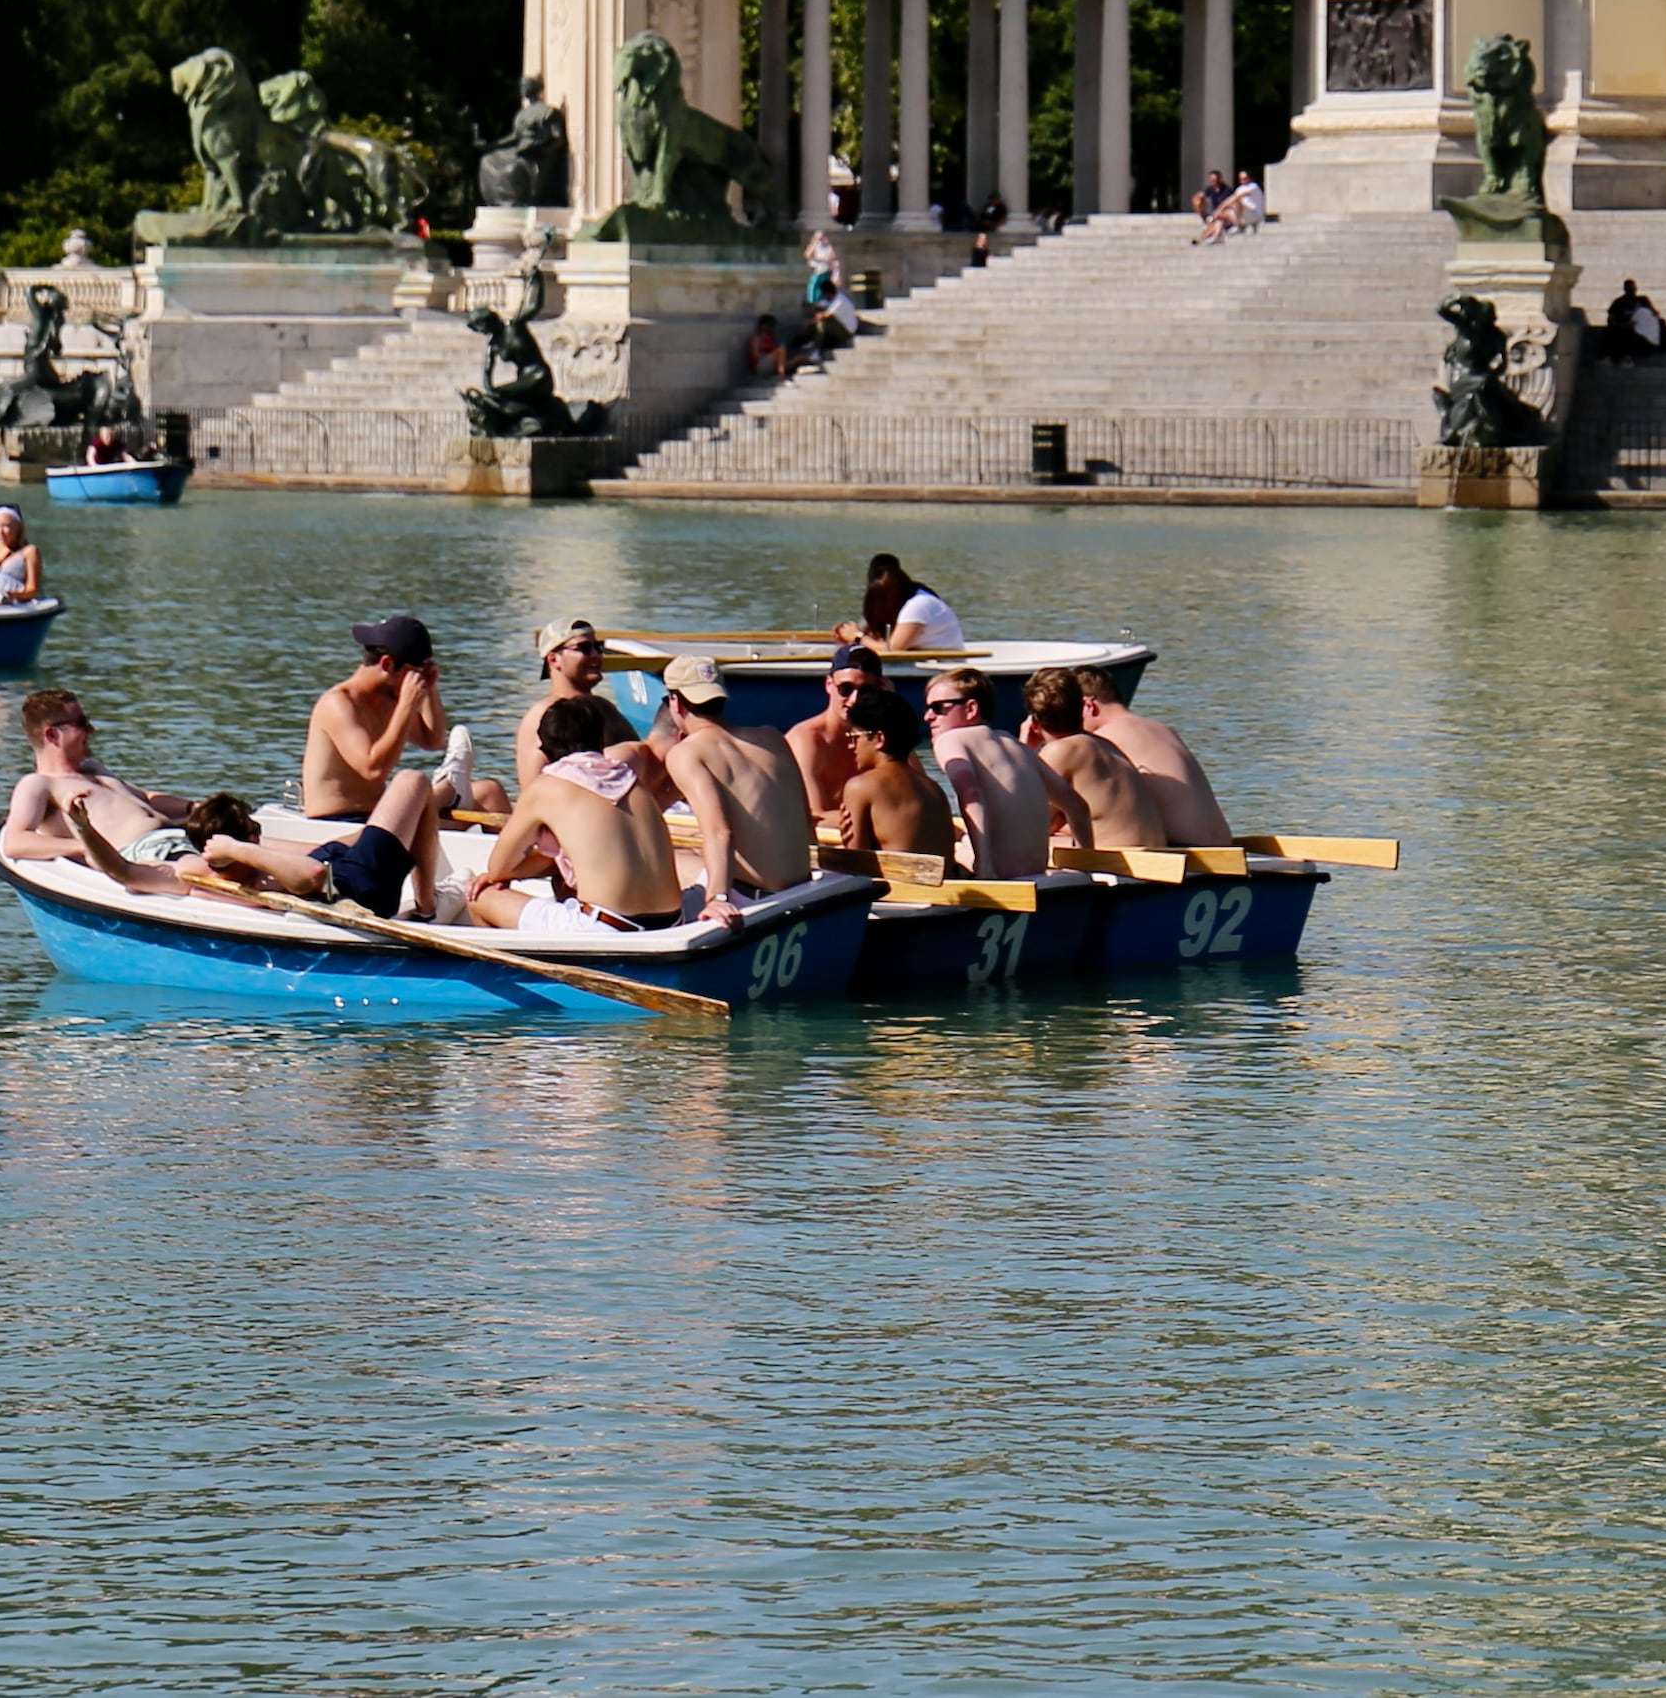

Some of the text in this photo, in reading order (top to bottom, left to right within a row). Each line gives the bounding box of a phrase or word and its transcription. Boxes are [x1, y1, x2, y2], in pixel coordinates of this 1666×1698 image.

[966, 912, 1030, 982] 31
[1178, 885, 1253, 958] 92
[747, 920, 808, 1000] 96
